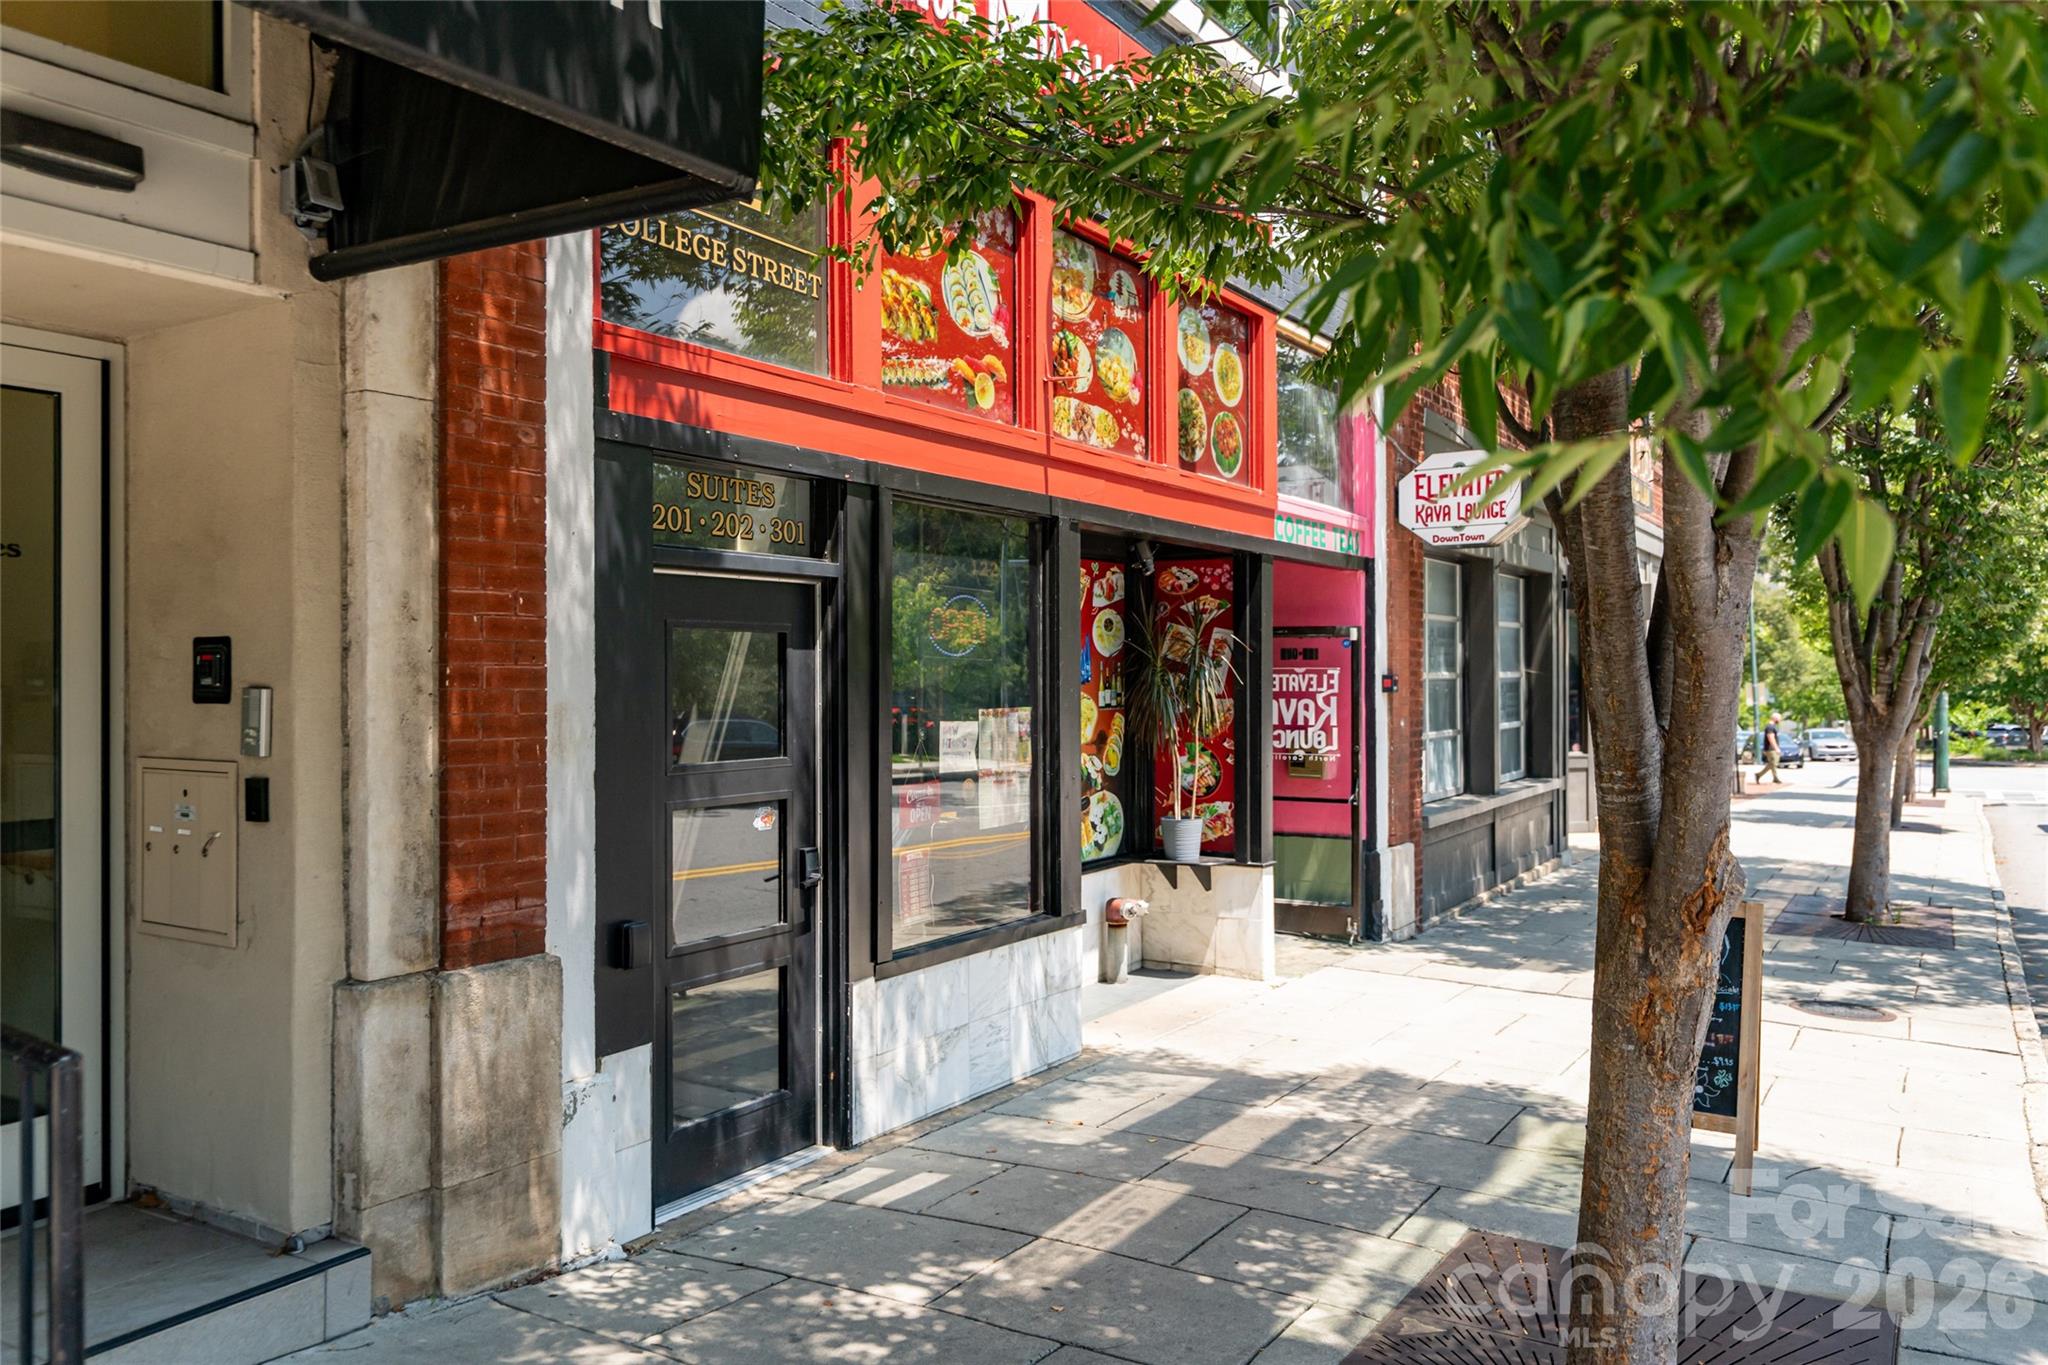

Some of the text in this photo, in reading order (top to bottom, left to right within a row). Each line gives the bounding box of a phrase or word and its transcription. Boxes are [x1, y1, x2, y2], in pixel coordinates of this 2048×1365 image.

[606, 216, 822, 298] OLLEGE STREET
[687, 472, 775, 508] SUITES
[1414, 469, 1506, 504] ELEVATE
[652, 503, 805, 545] 201 202 301
[1275, 514, 1327, 548] COFFEE
[1415, 504, 1451, 527] KAVA
[1432, 533, 1485, 543] DownTown
